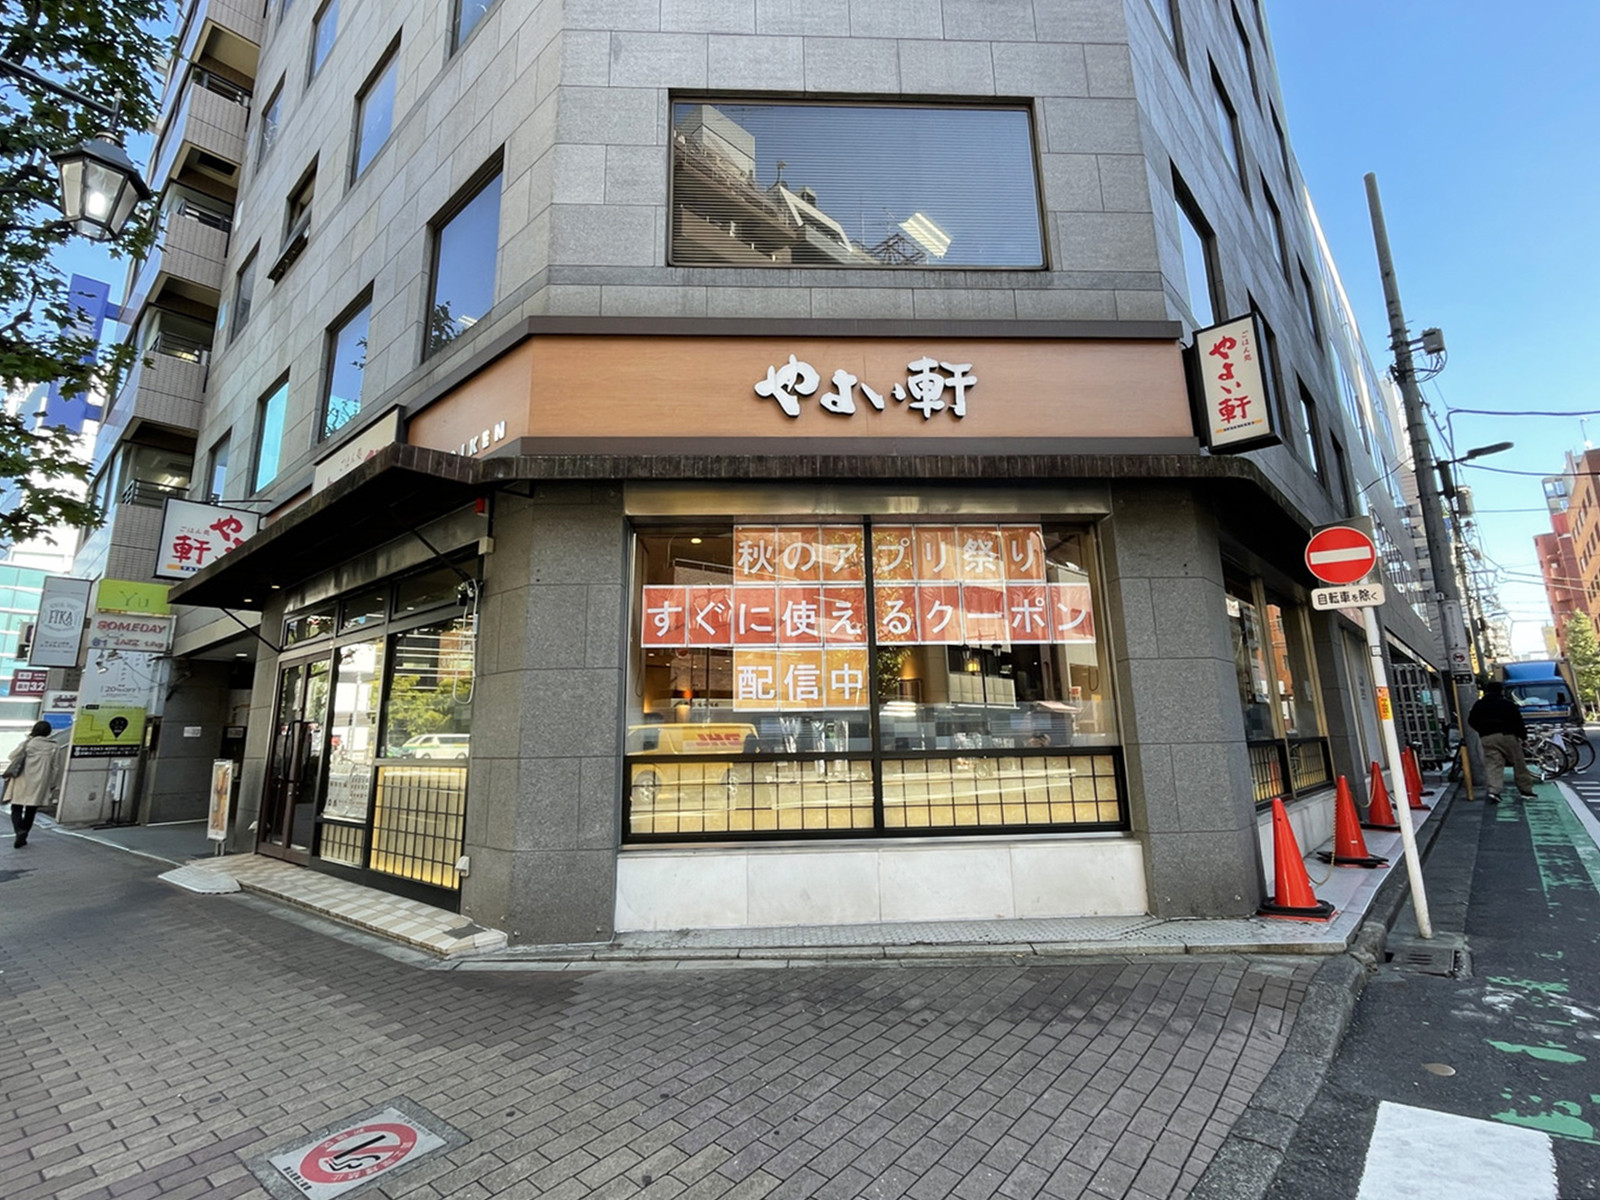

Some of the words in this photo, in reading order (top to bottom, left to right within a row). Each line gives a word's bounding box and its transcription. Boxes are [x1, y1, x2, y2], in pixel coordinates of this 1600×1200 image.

[754, 354, 978, 420] やよい軒
[1209, 336, 1252, 424] やよい軒
[450, 420, 506, 458] IKEN
[737, 536, 1037, 575] 秋のアプリ祭り
[1317, 588, 1378, 606] 自転車を除く
[97, 620, 166, 634] SOMEDAY
[647, 597, 1087, 637] すぐに使えるクーポン
[737, 663, 864, 700] 配信中
